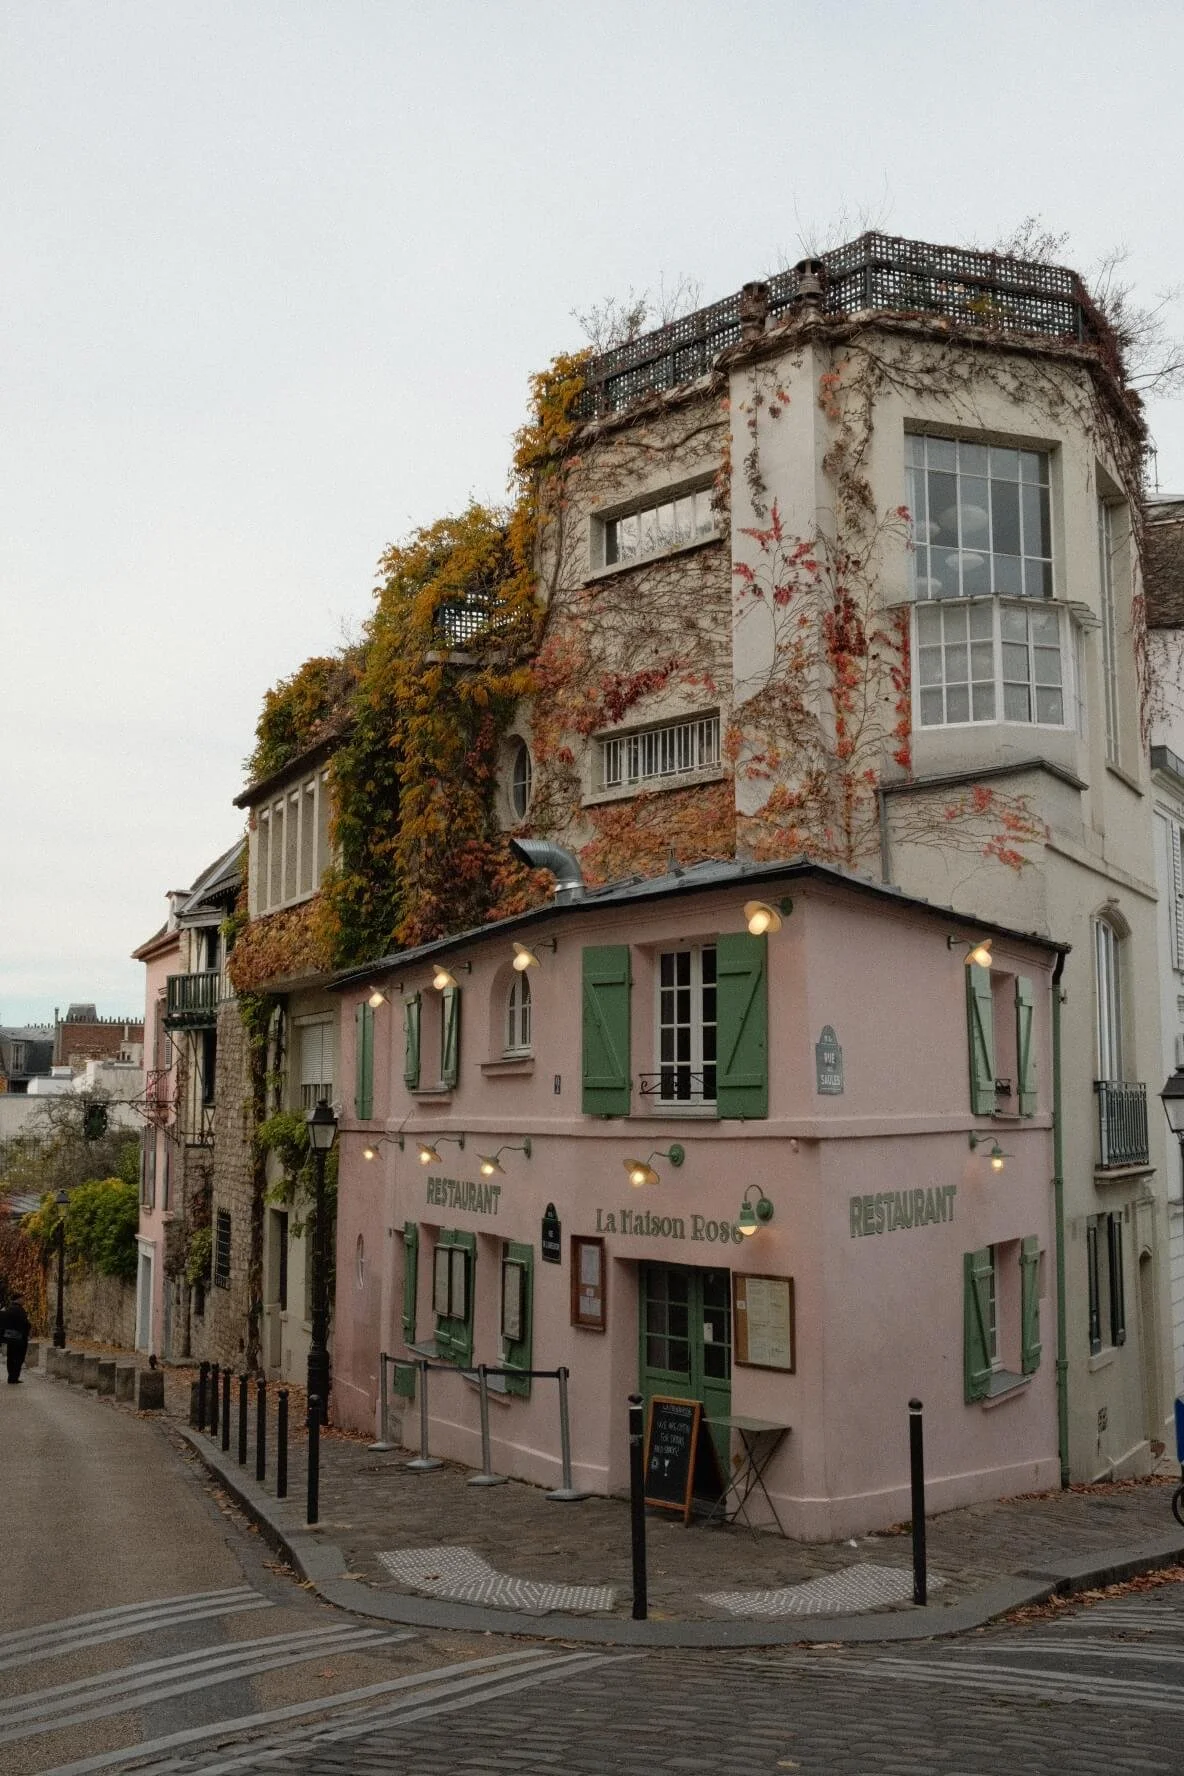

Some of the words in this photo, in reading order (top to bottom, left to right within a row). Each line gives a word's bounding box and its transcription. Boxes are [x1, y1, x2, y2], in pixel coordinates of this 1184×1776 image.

[427, 1176, 501, 1215] RESTAURANT
[850, 1184, 957, 1238] RESTAURANT
[595, 1208, 617, 1234] La
[620, 1208, 685, 1240] Maison
